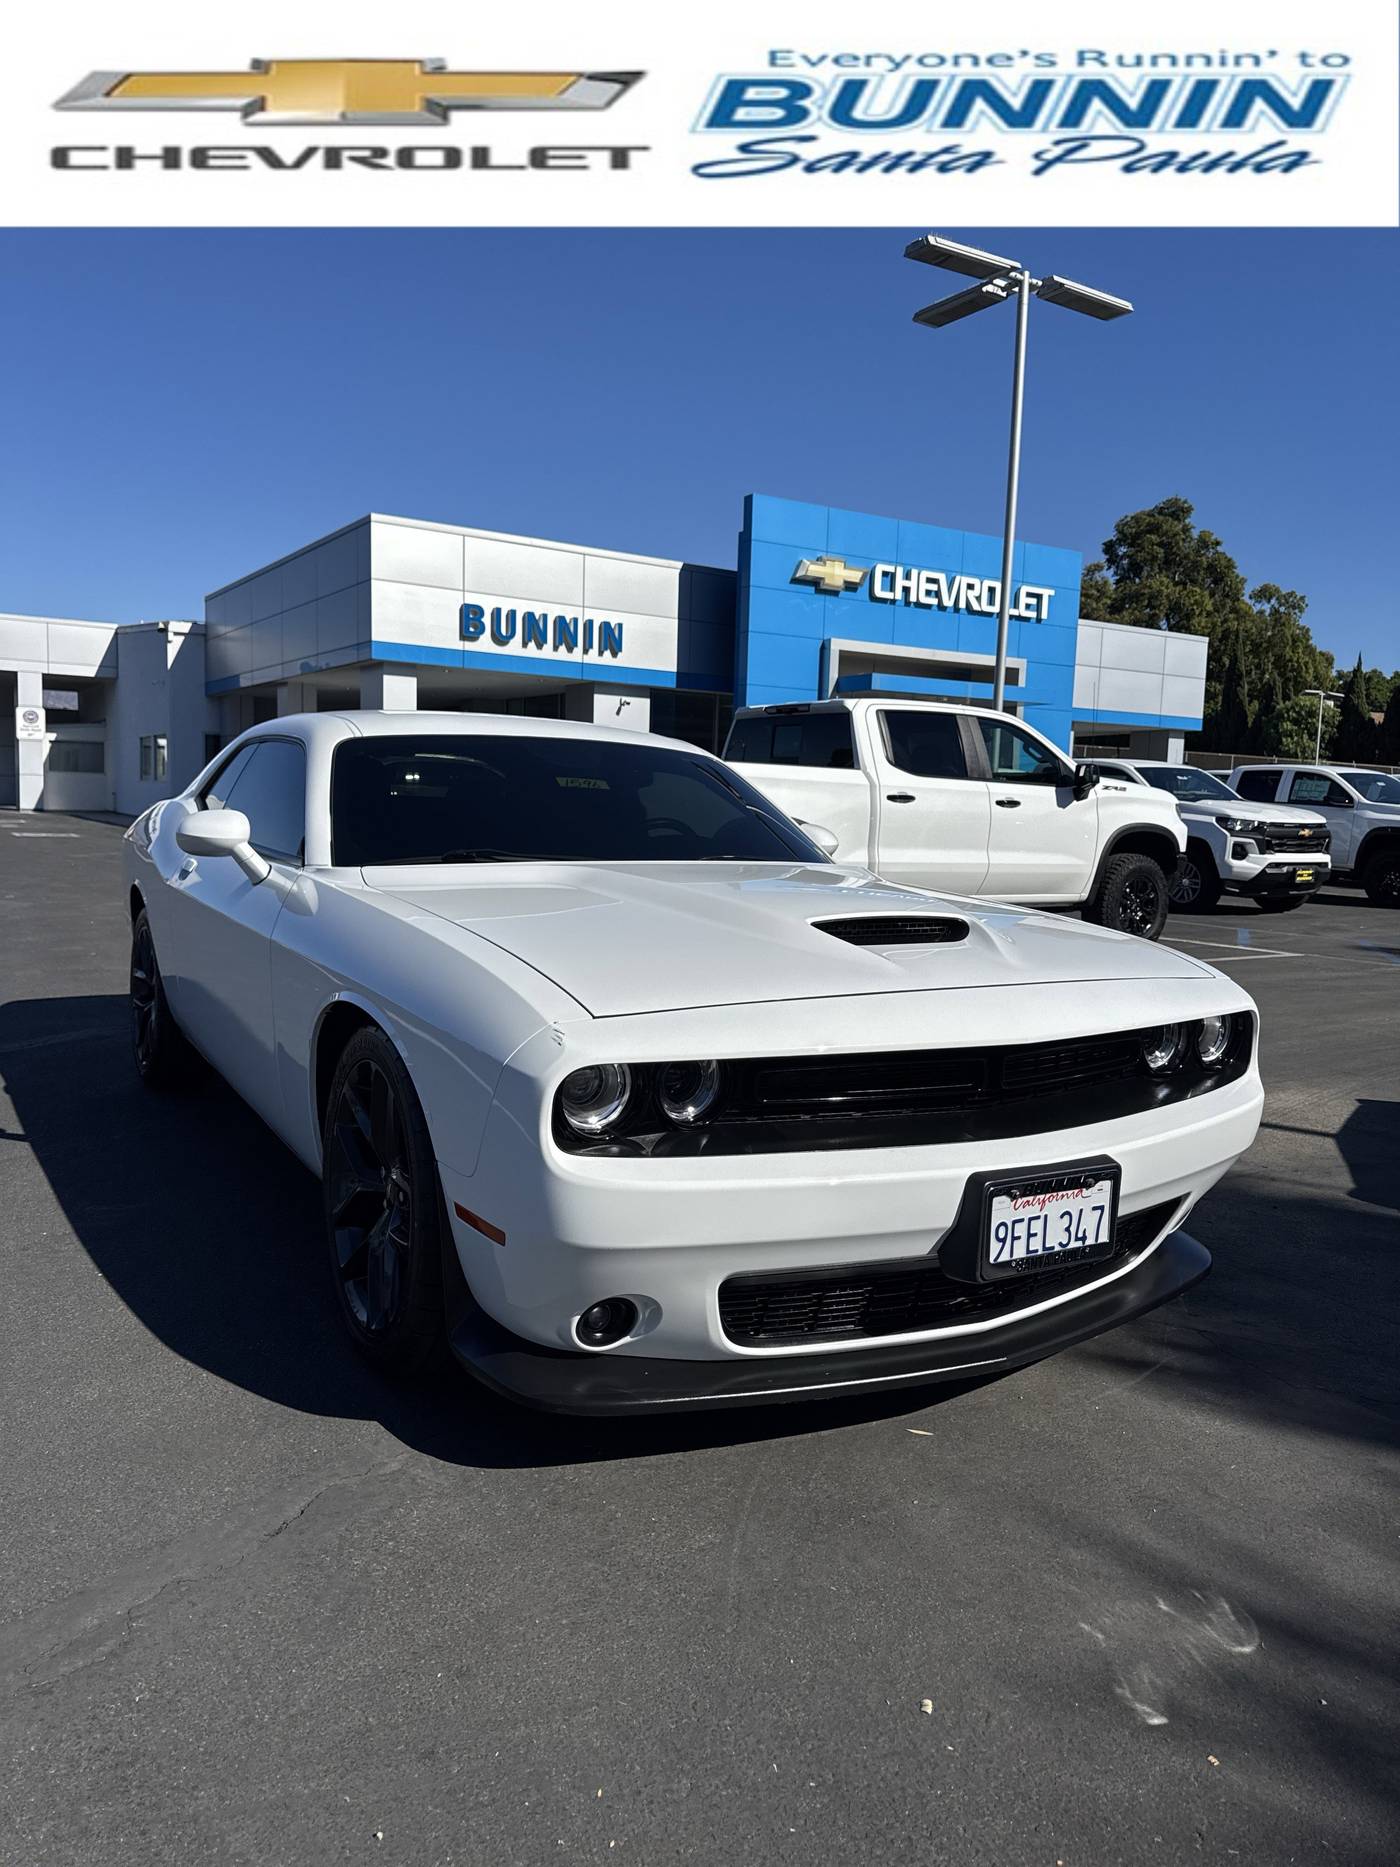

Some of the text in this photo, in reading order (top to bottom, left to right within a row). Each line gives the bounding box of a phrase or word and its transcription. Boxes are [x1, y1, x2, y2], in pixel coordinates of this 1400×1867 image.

[459, 603, 623, 658] BUNNIN
[1012, 1188, 1092, 1212] California
[992, 1204, 1105, 1264] 9FEL347
